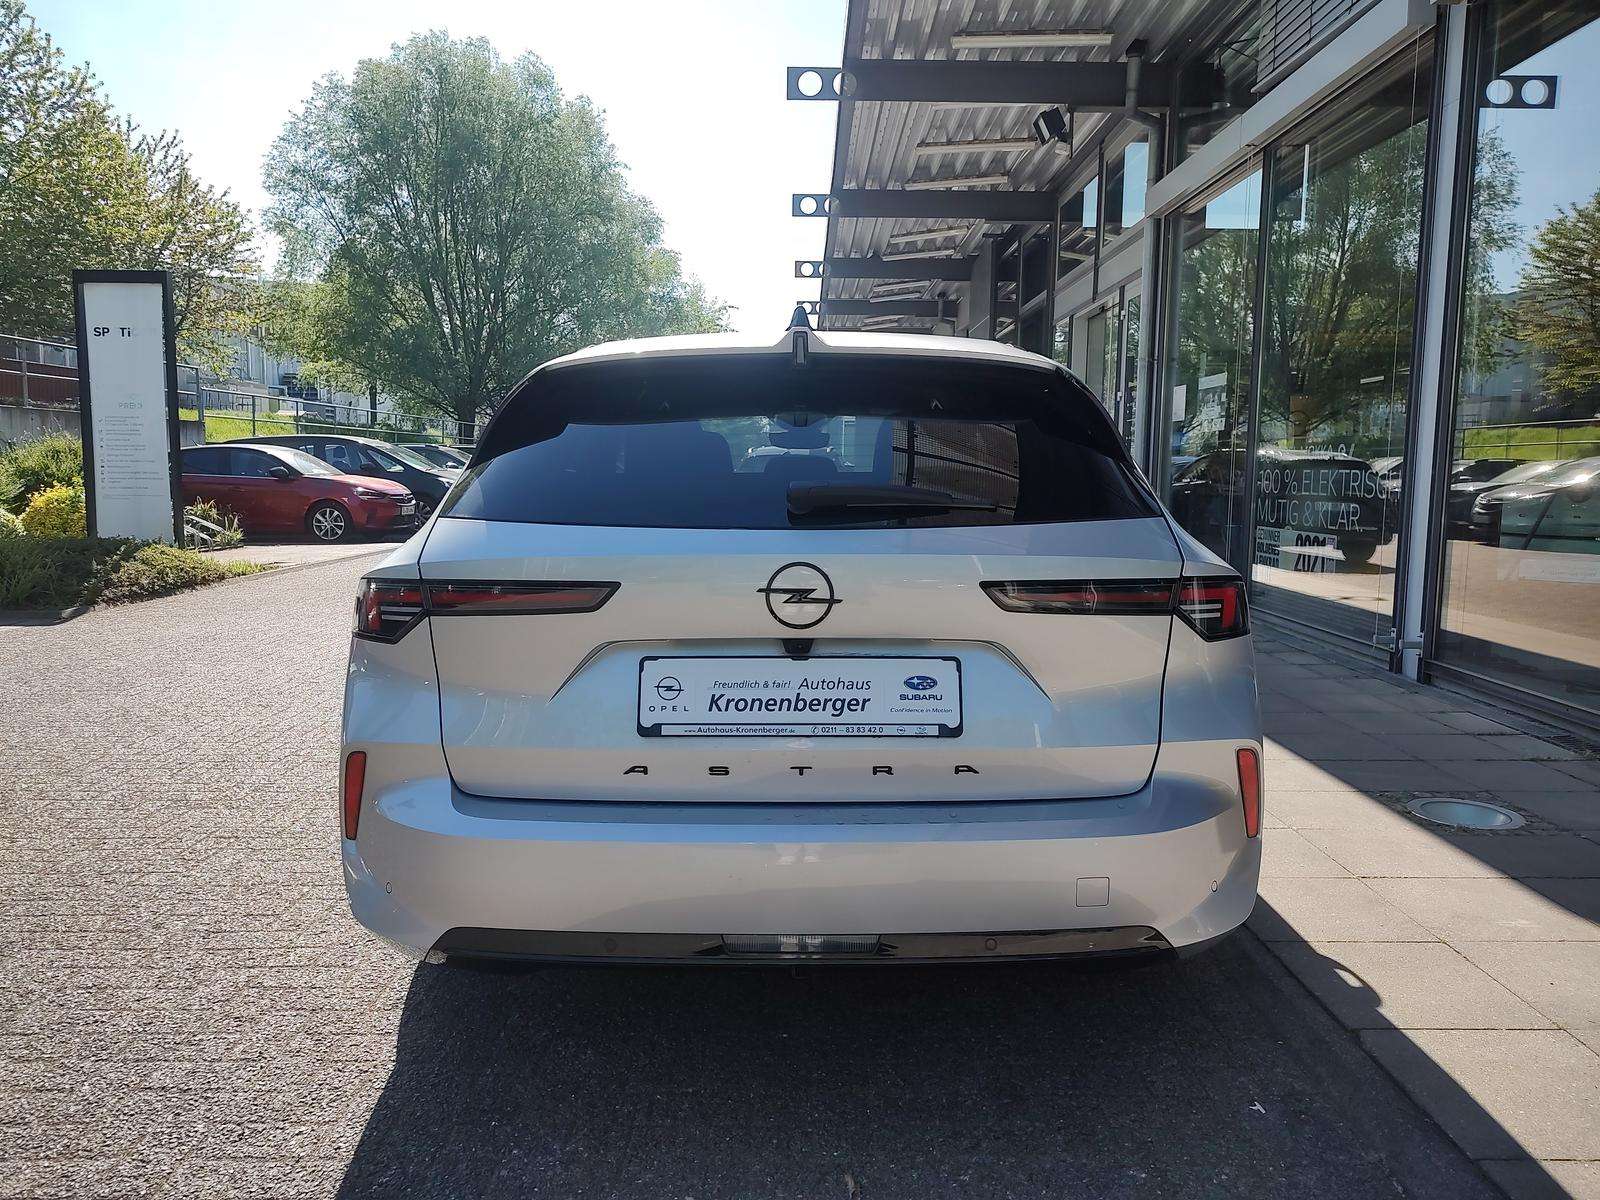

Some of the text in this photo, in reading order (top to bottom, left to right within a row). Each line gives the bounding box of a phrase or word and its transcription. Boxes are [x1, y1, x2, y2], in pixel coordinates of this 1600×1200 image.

[1257, 498, 1300, 525] MUTIG
[1302, 501, 1314, 528] &
[713, 677, 872, 690] Freundlich & fair! Autohaus
[899, 693, 943, 701] SUBARU
[708, 693, 872, 717] Kronenberger
[821, 726, 838, 734] 0211
[845, 726, 855, 734] 83
[856, 726, 866, 734] 83
[867, 726, 877, 734] 42
